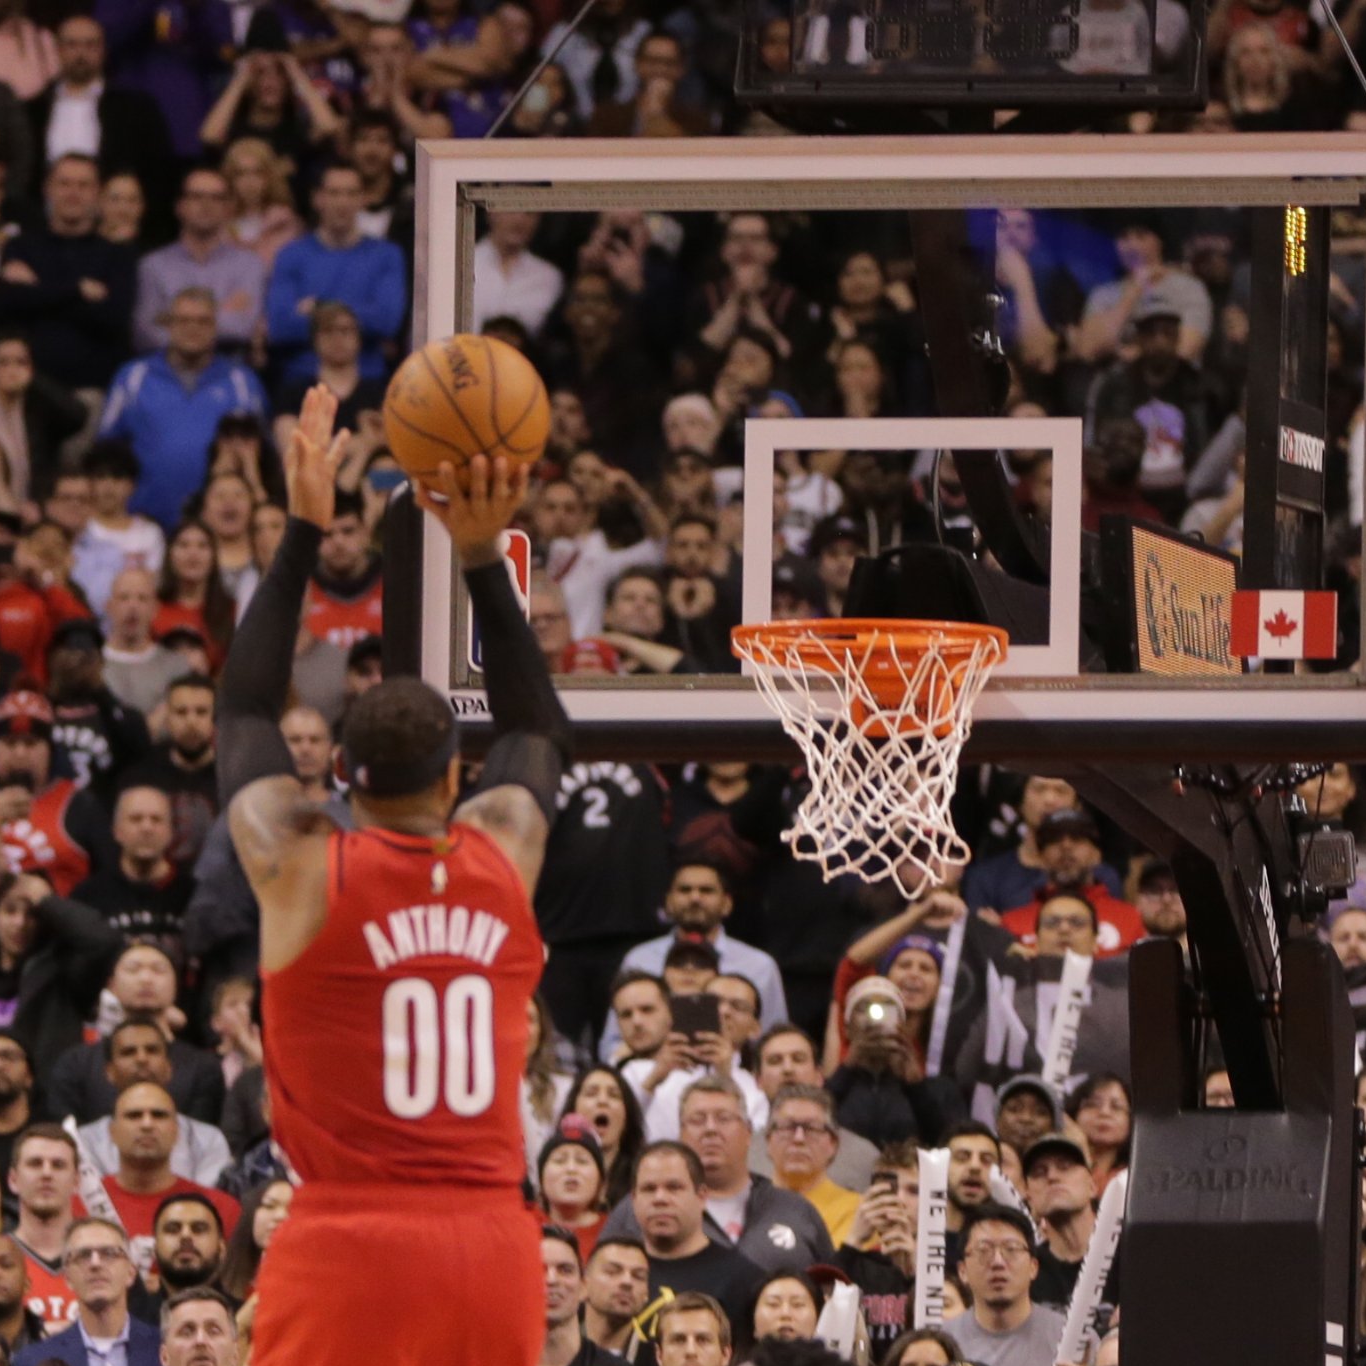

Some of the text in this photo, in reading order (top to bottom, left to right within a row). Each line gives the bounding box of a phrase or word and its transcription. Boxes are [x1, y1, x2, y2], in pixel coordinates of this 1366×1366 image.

[583, 786, 611, 828] 2
[362, 903, 510, 971] ANTHONY
[382, 973, 496, 1120] 00
[927, 1231, 948, 1274] THE
